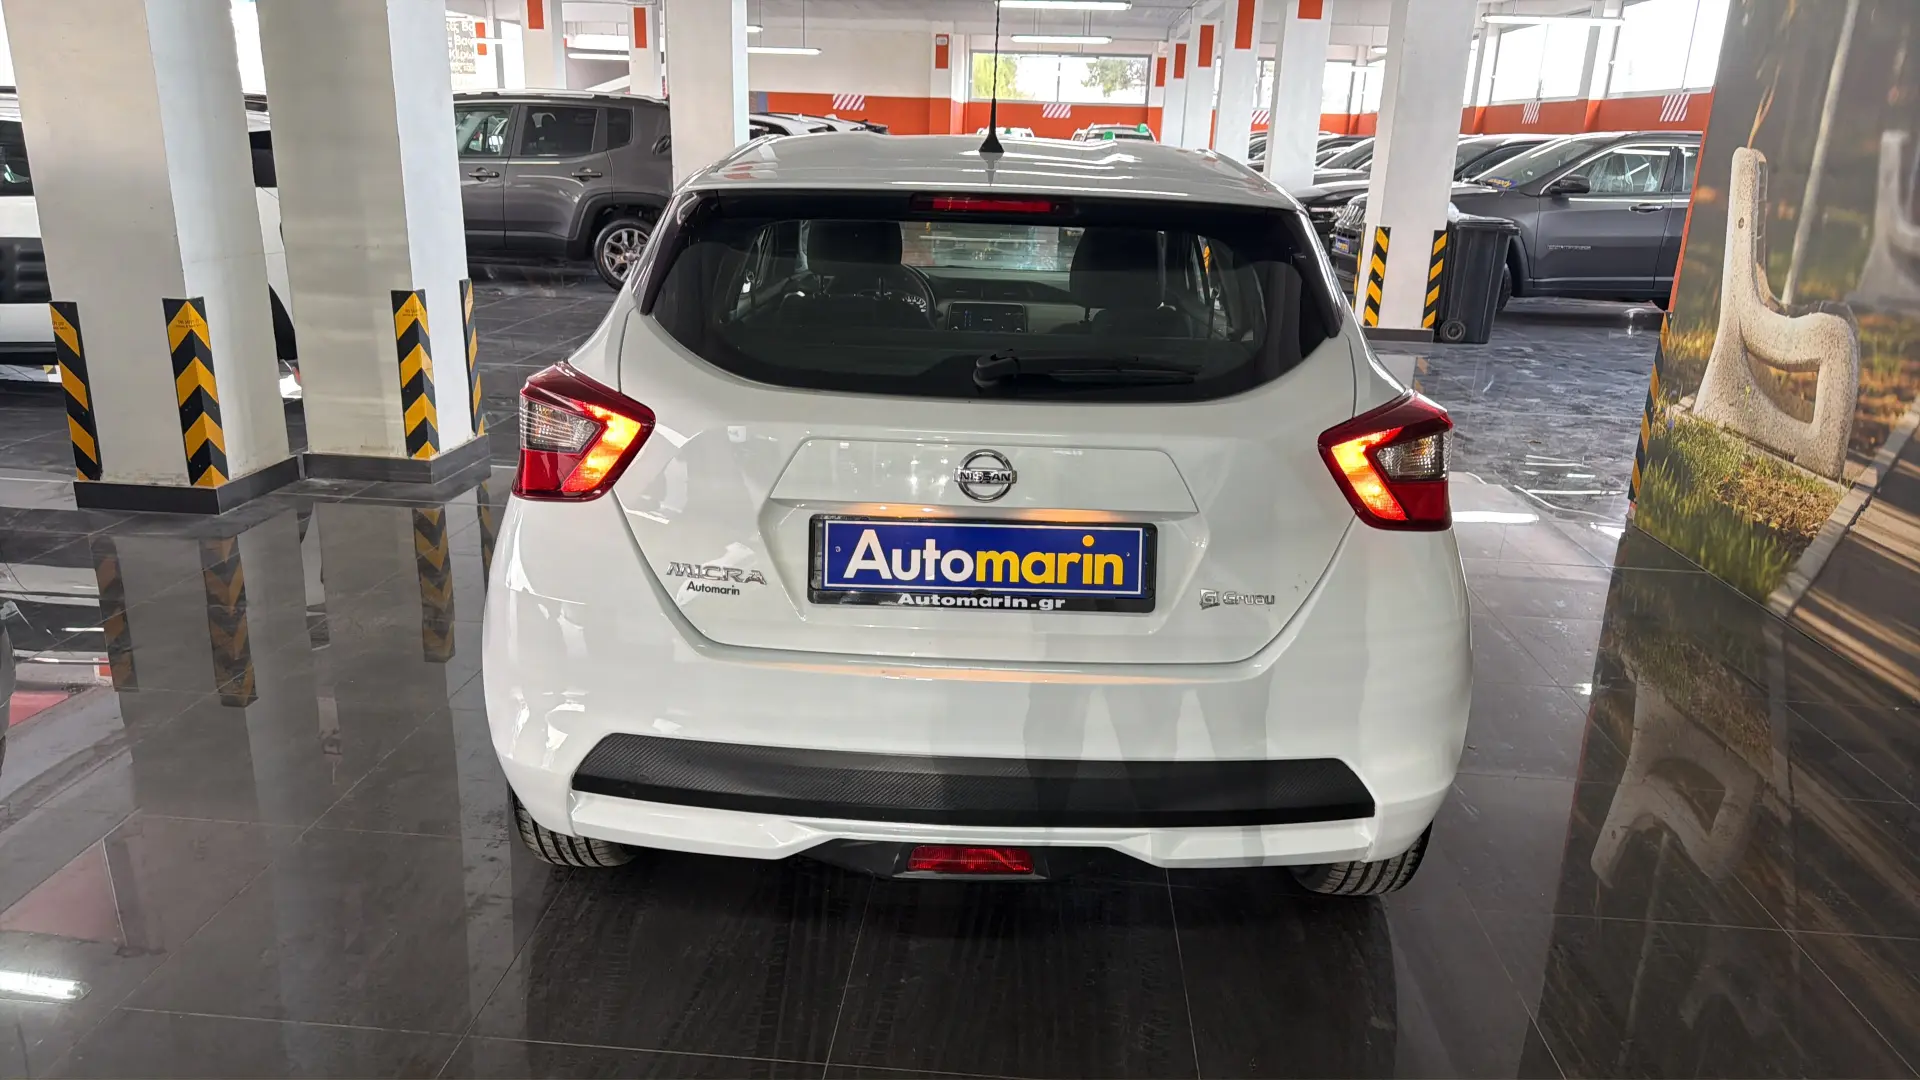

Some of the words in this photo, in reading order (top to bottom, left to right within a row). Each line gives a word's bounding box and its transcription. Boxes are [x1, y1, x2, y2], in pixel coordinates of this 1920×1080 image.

[959, 471, 1011, 482] NISSAN
[842, 529, 1124, 586] Automarin
[666, 561, 767, 585] MICRA
[686, 580, 740, 595] Automarin
[897, 592, 1066, 610] Automarin.gr
[1223, 591, 1275, 605] Gruau
